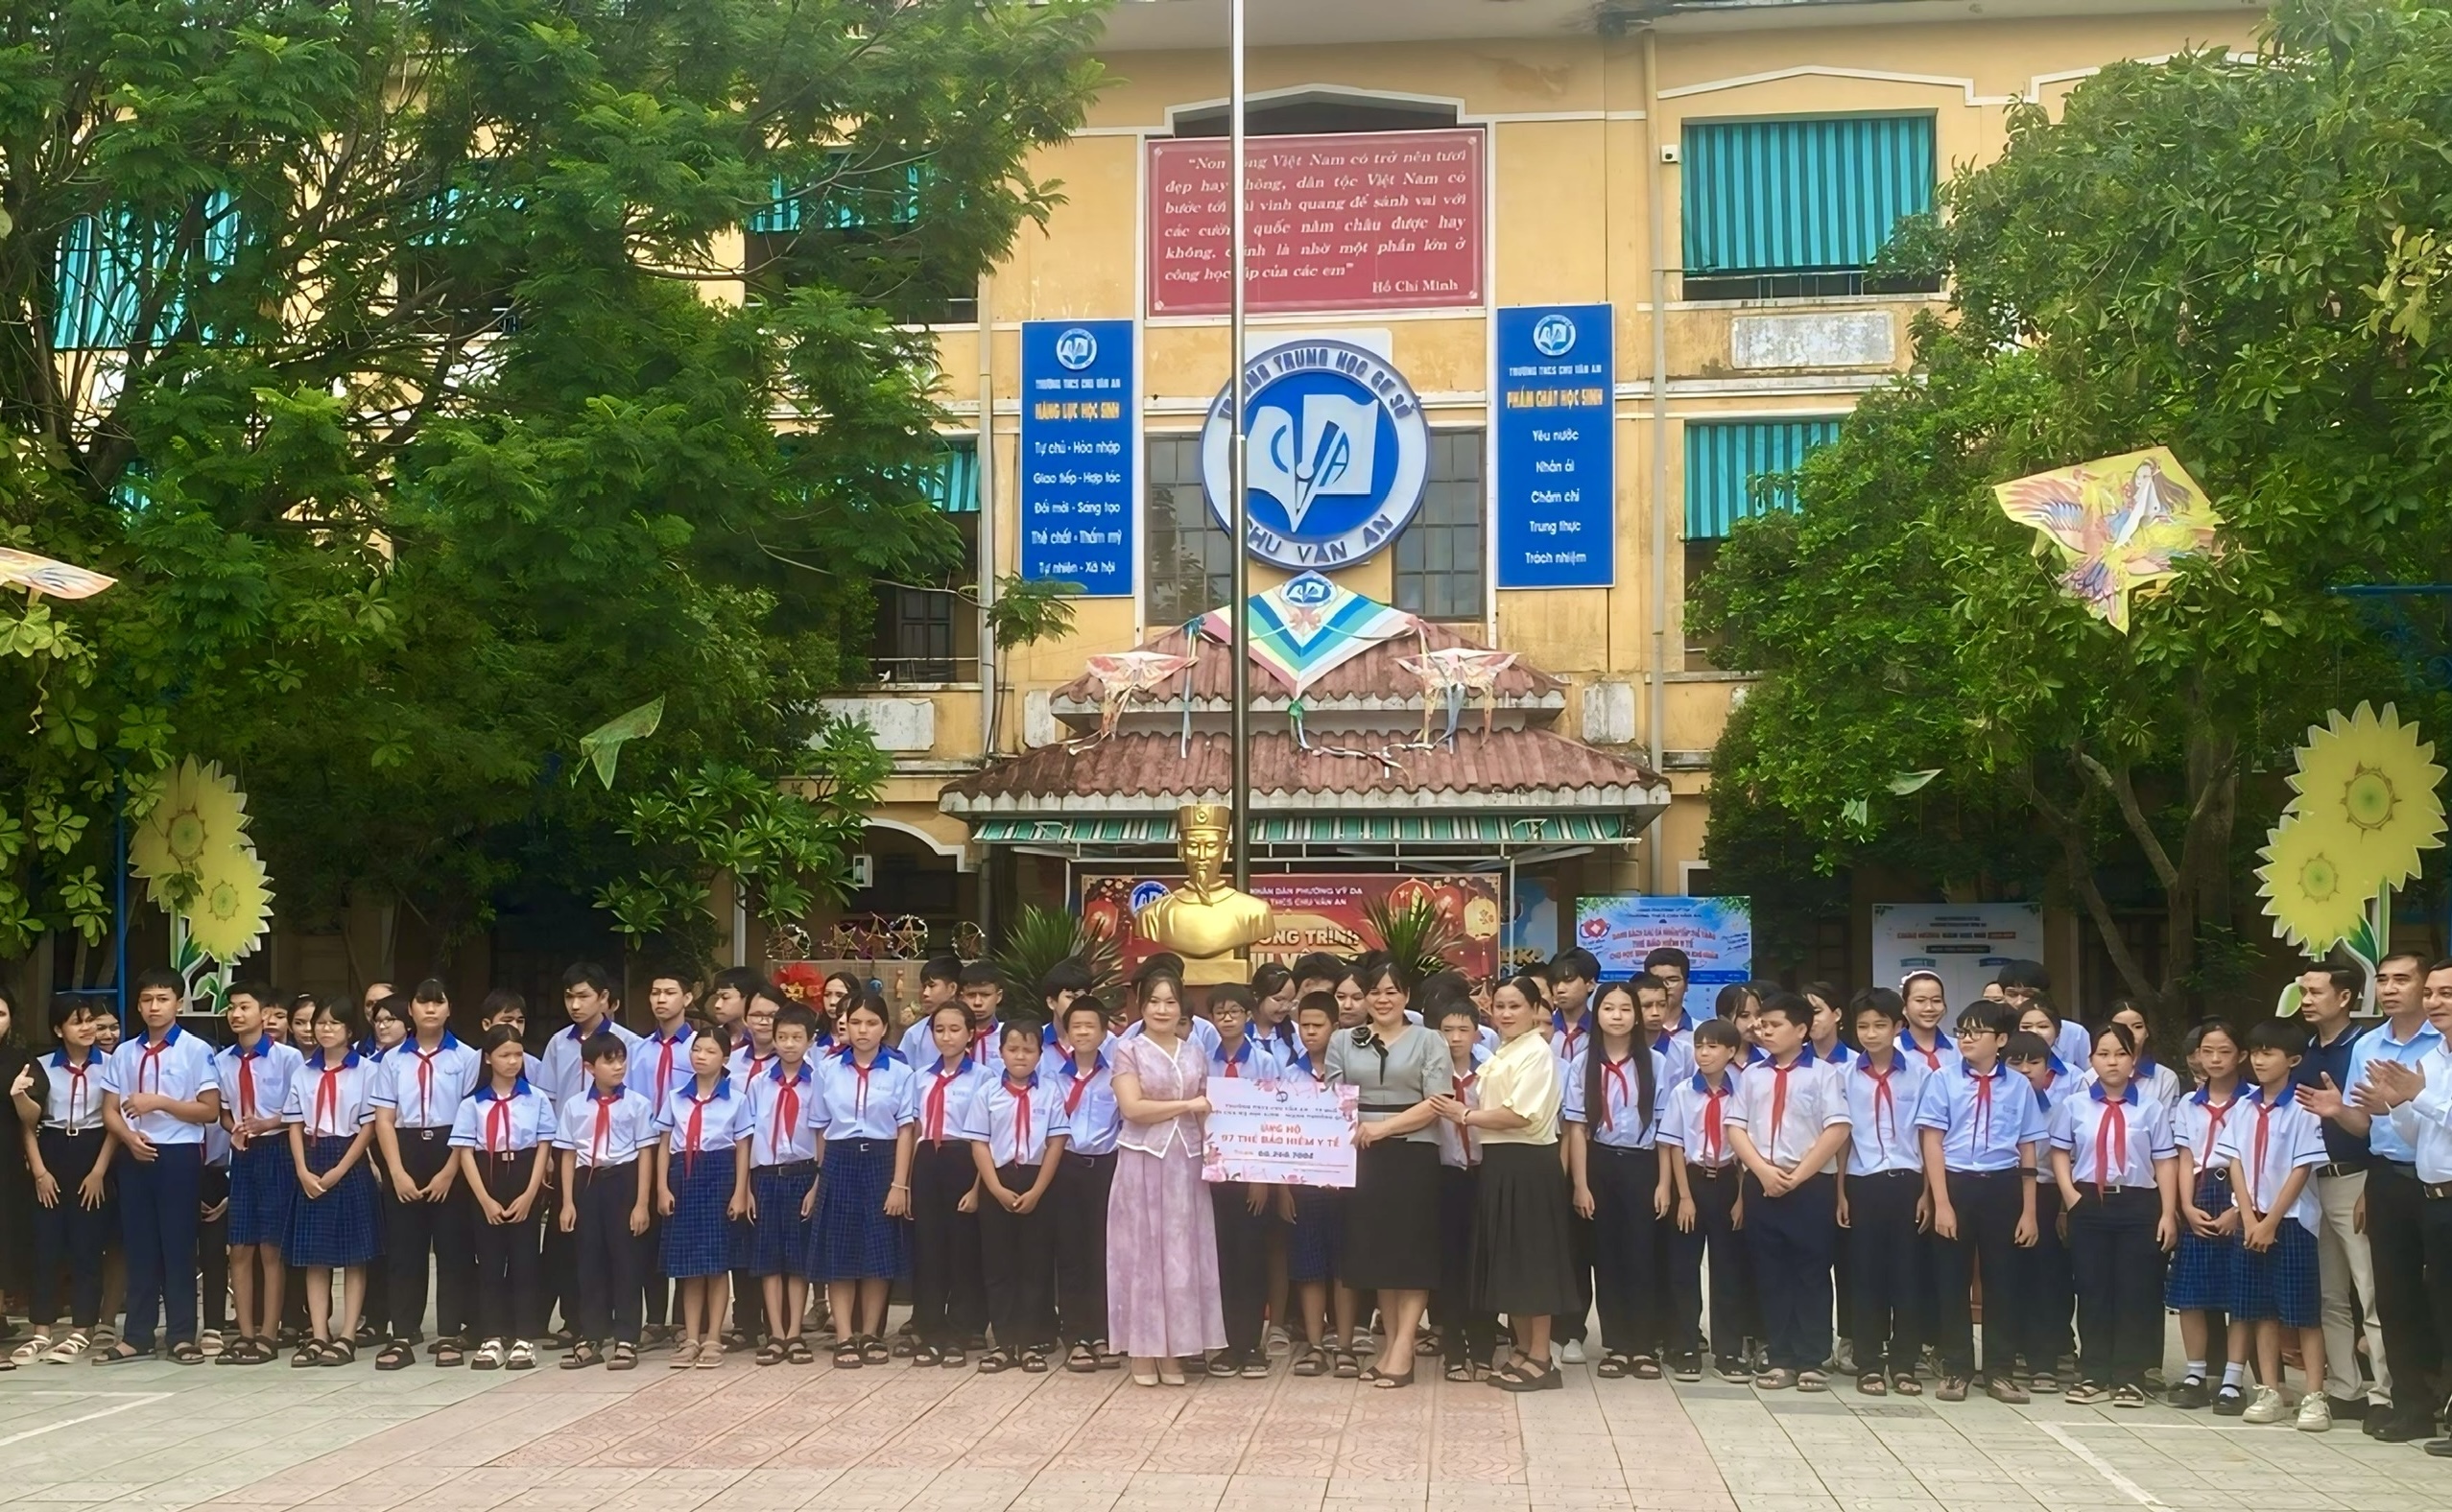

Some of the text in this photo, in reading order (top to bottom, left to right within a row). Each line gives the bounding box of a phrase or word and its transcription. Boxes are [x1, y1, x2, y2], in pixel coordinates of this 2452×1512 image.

[1273, 154, 1302, 169] Việt
[1309, 154, 1345, 166] Nam
[1349, 154, 1369, 165] có
[1374, 151, 1398, 164] trở
[1403, 151, 1431, 163] nên
[1437, 150, 1466, 162] tươi
[1165, 171, 1466, 195] đẹp hay hông, dân tộc Việt Nam có
[1165, 201, 1202, 214] bước
[1207, 200, 1226, 213] tới
[1260, 198, 1292, 211] vinh
[1297, 199, 1345, 212] quang
[1373, 195, 1409, 208] sánh
[1415, 195, 1436, 206] vai
[1443, 193, 1466, 205] với
[1164, 223, 1190, 237] các
[1253, 218, 1291, 237] quốc
[1300, 220, 1334, 233] năm
[1344, 218, 1381, 231] châu
[1391, 216, 1428, 232] được
[1438, 214, 1466, 231] hay
[1276, 243, 1290, 255] là
[1300, 242, 1332, 255] nhờ
[1339, 241, 1369, 256] một
[1424, 237, 1447, 251] lớn
[1455, 235, 1466, 250] ở
[1164, 268, 1202, 283] công
[1203, 267, 1231, 283] học
[1262, 264, 1288, 277] của
[1293, 264, 1319, 276] các
[1372, 278, 1459, 294] Hồ Chí Minh
[1274, 348, 1328, 372] TRUNG
[1533, 429, 1551, 442] Yêu
[1034, 472, 1057, 484] Giao
[1083, 471, 1104, 485] Hợp
[1106, 470, 1121, 484] tác
[1077, 501, 1102, 516] Sáng
[1105, 502, 1121, 515] tạo
[1363, 513, 1394, 548] AN
[1529, 520, 1582, 535] Trung thực
[1525, 551, 1587, 566] Trách nhiệm
